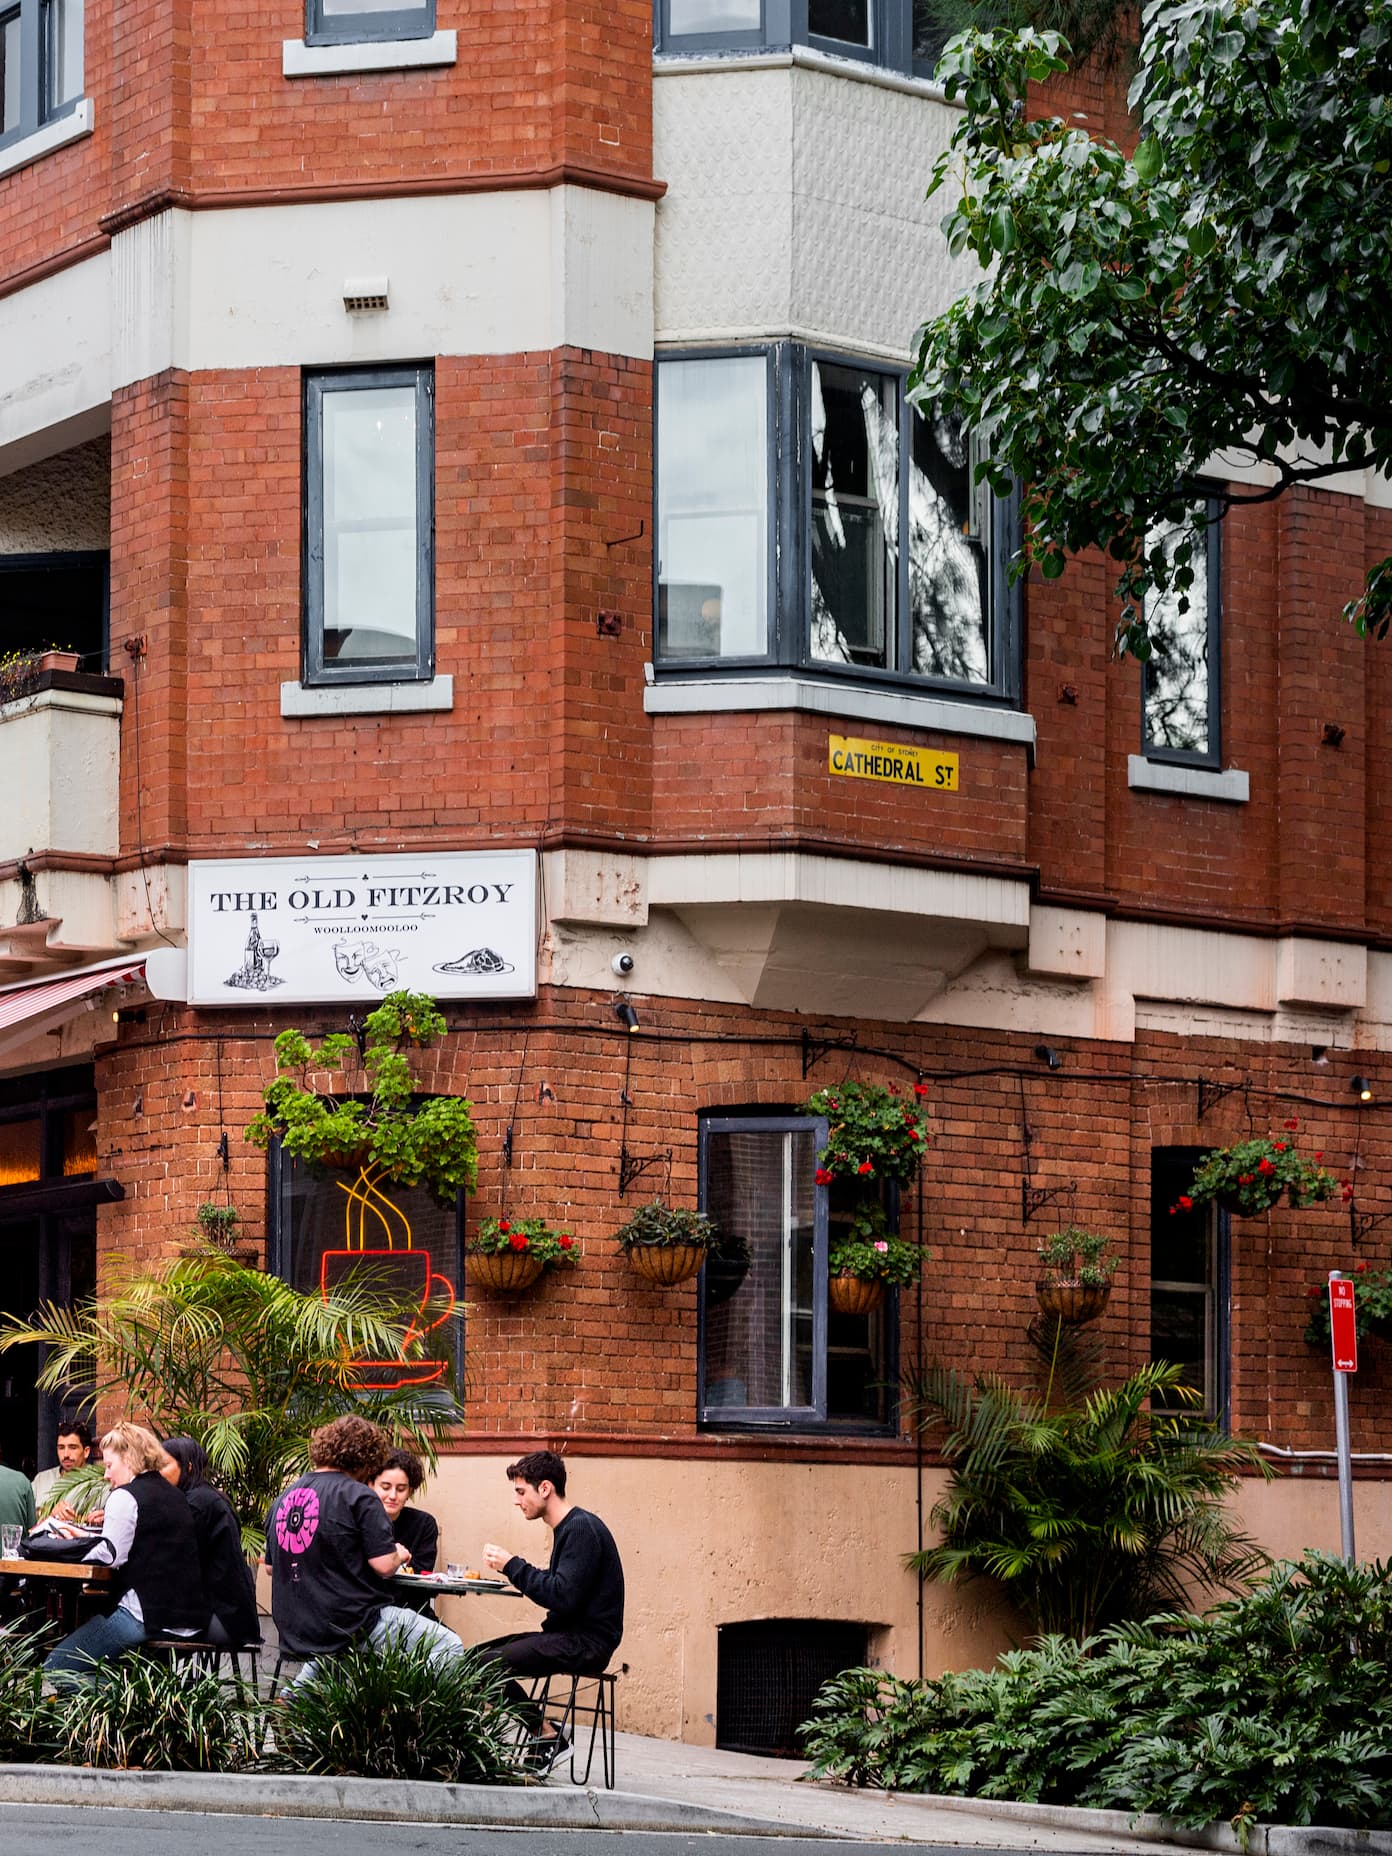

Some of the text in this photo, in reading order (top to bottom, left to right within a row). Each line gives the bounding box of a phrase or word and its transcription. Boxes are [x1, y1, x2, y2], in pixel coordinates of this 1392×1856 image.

[832, 750, 924, 783] CATHEDRAL
[210, 883, 516, 913] THE OLD FITZROY
[313, 923, 419, 935] WOOLLOOMOOLOO
[1338, 1285, 1346, 1297] NO
[1333, 1298, 1353, 1309] STOPPING
